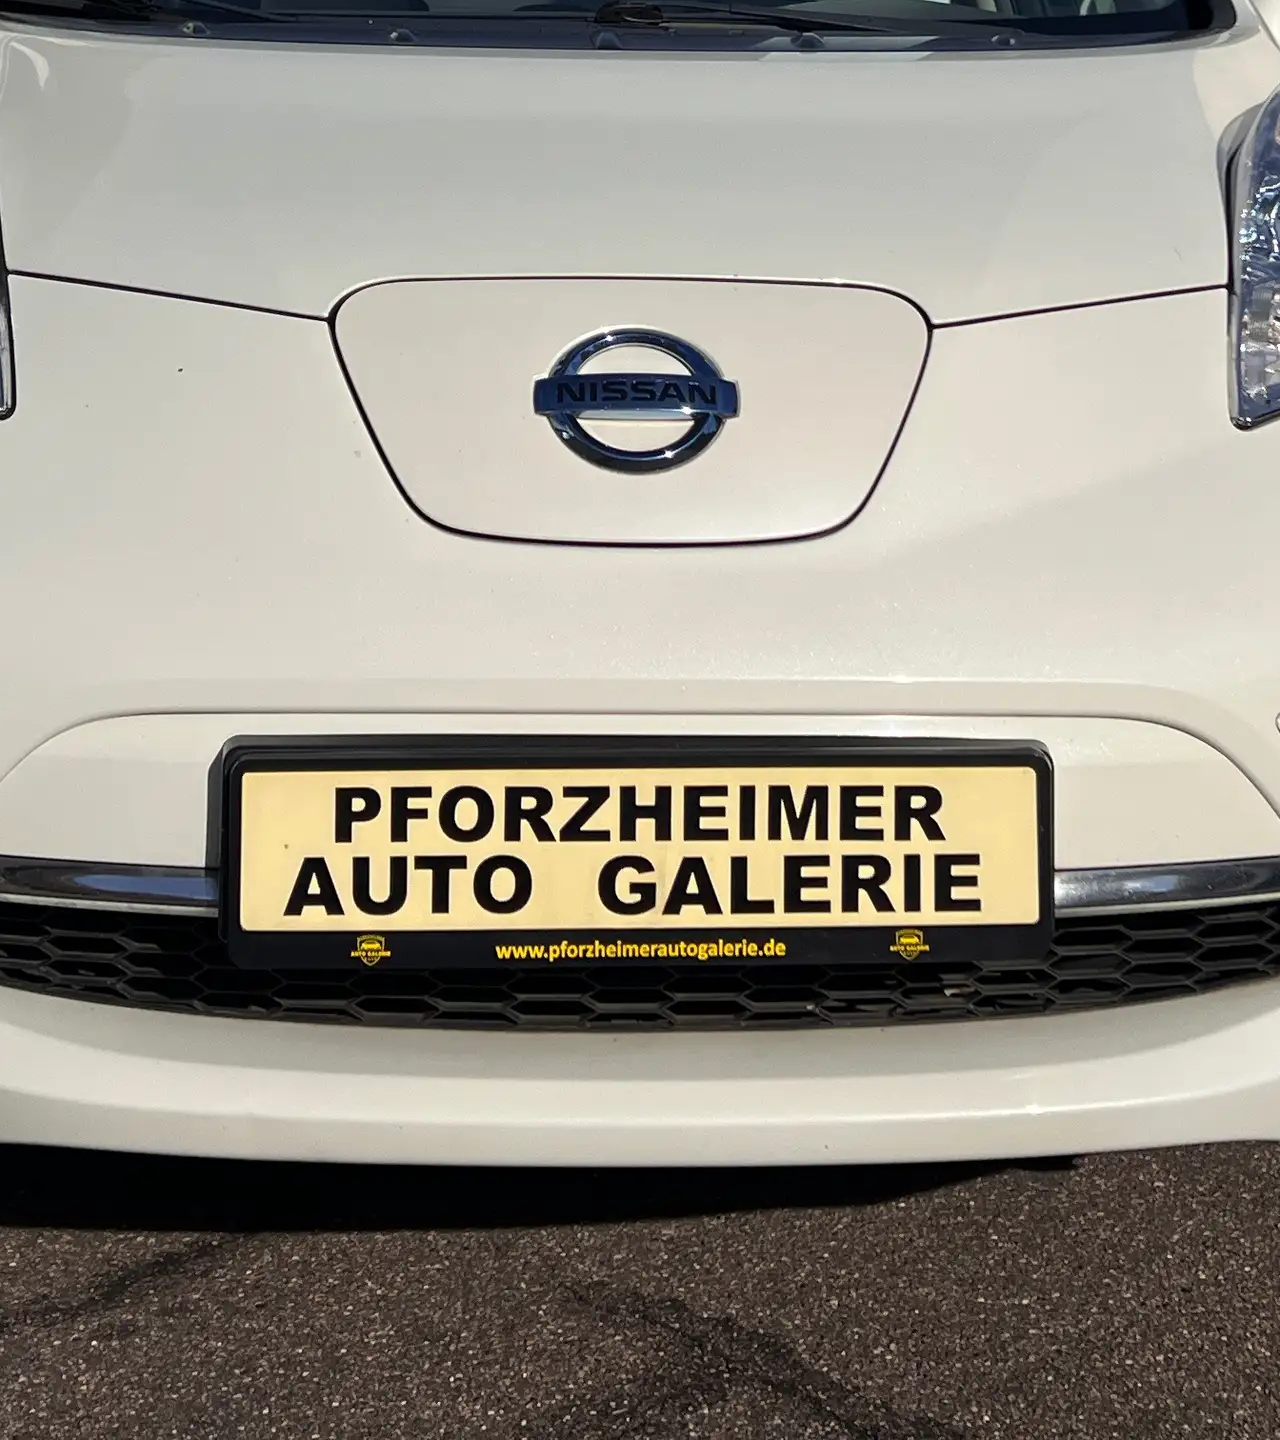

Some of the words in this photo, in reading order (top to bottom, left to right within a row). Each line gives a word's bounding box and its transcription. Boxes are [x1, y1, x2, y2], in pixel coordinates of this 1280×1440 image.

[557, 379, 717, 406] NISSAN
[334, 784, 946, 844] PFORZHEIMER
[284, 853, 534, 918] AUTO
[595, 852, 983, 918] GALERIE
[495, 937, 787, 962] www.pforzheimerautogalerie.de
